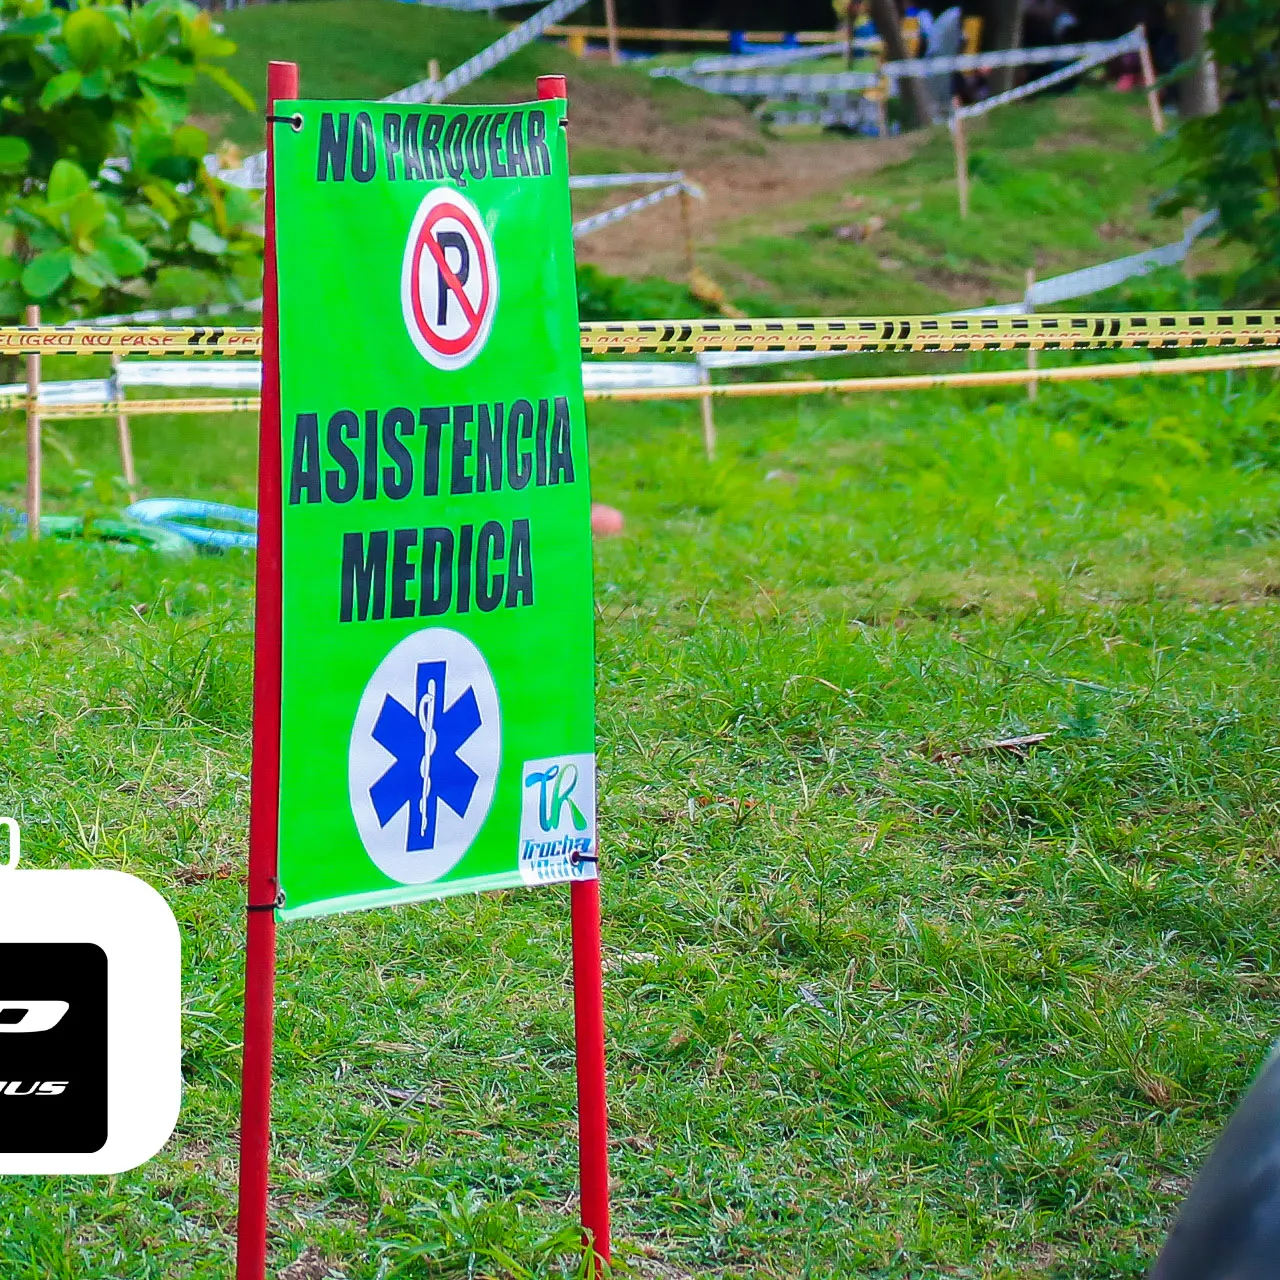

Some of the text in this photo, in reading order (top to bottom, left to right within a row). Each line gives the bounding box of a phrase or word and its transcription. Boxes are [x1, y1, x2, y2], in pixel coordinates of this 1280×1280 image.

[316, 110, 552, 187] NO PARQUEAR
[289, 396, 575, 505] ASISTENCIA
[339, 518, 534, 623] MEDICA
